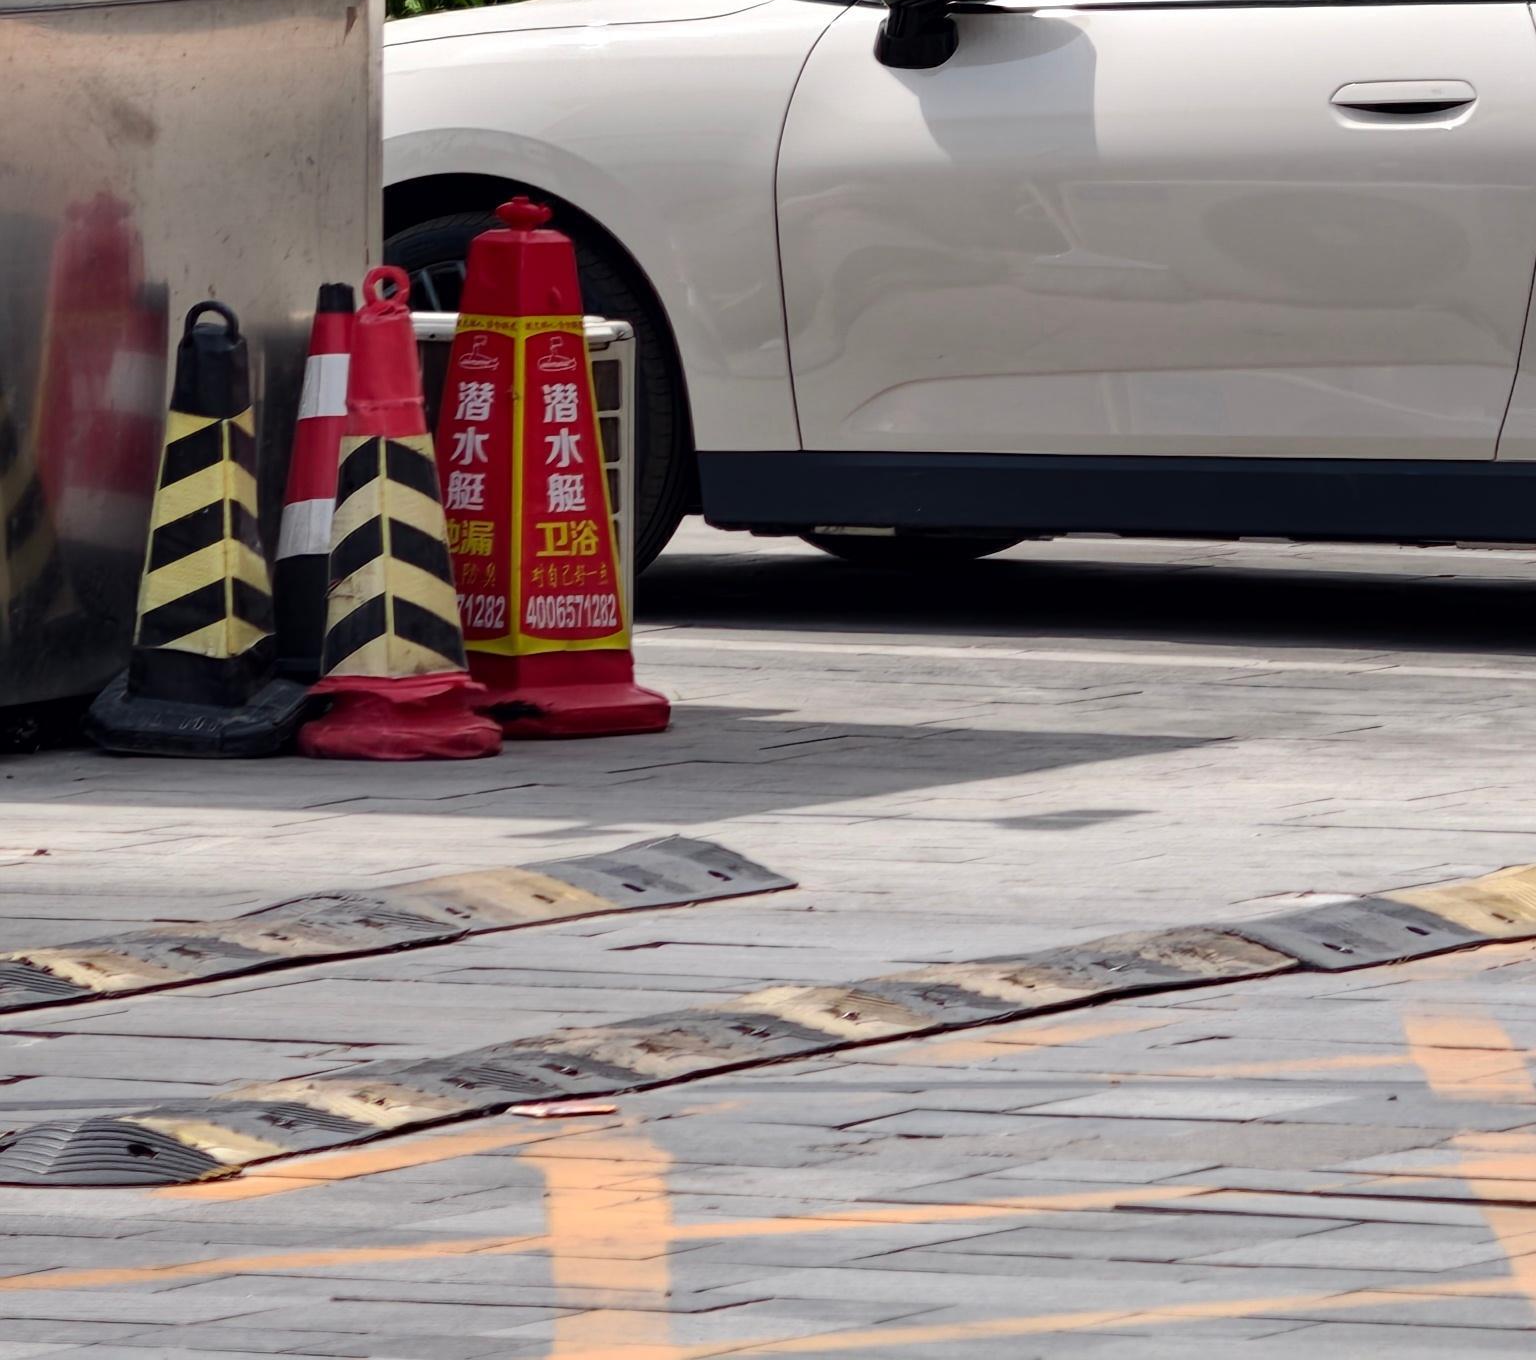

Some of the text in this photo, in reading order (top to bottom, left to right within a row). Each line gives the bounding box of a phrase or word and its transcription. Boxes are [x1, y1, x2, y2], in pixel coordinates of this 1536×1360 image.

[445, 381, 495, 511] 潜水艇
[542, 382, 587, 513] 潜水艇
[535, 519, 599, 557] 卫浴
[525, 593, 618, 629] 4006571282
